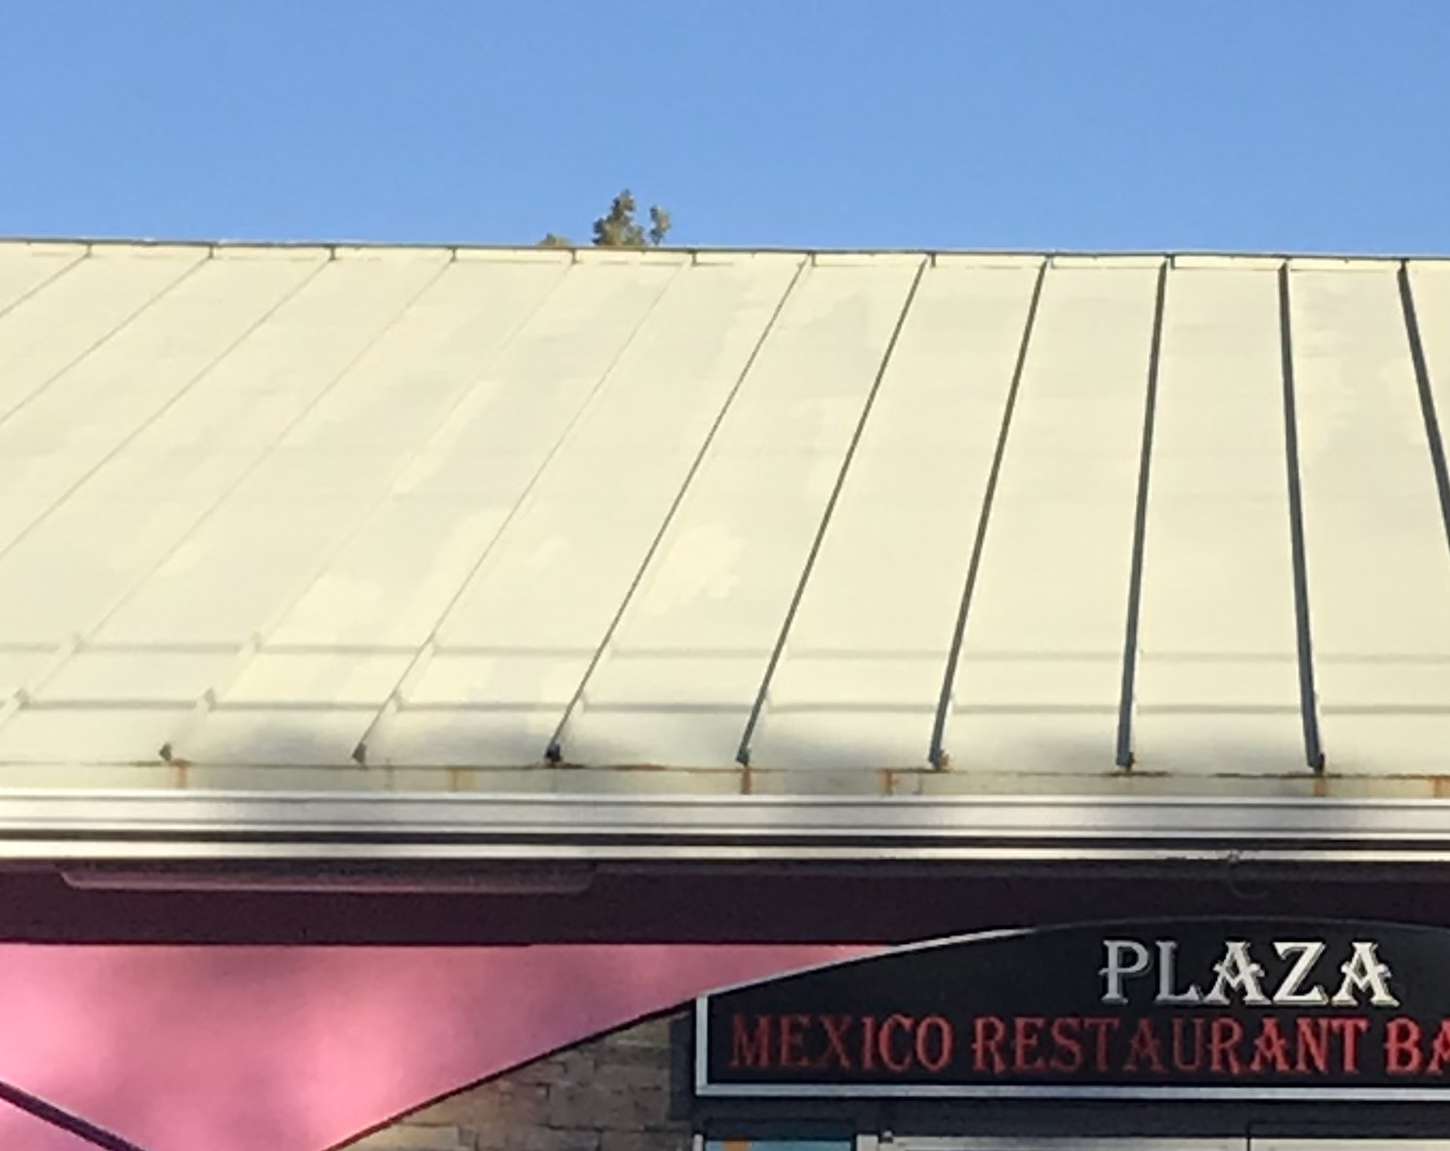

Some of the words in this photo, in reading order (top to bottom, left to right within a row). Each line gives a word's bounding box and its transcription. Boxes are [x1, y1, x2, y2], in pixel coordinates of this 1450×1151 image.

[1098, 939, 1400, 1007] PLAZA
[729, 1013, 952, 1072] MEXICO
[971, 1015, 1370, 1075] RESTAURANT
